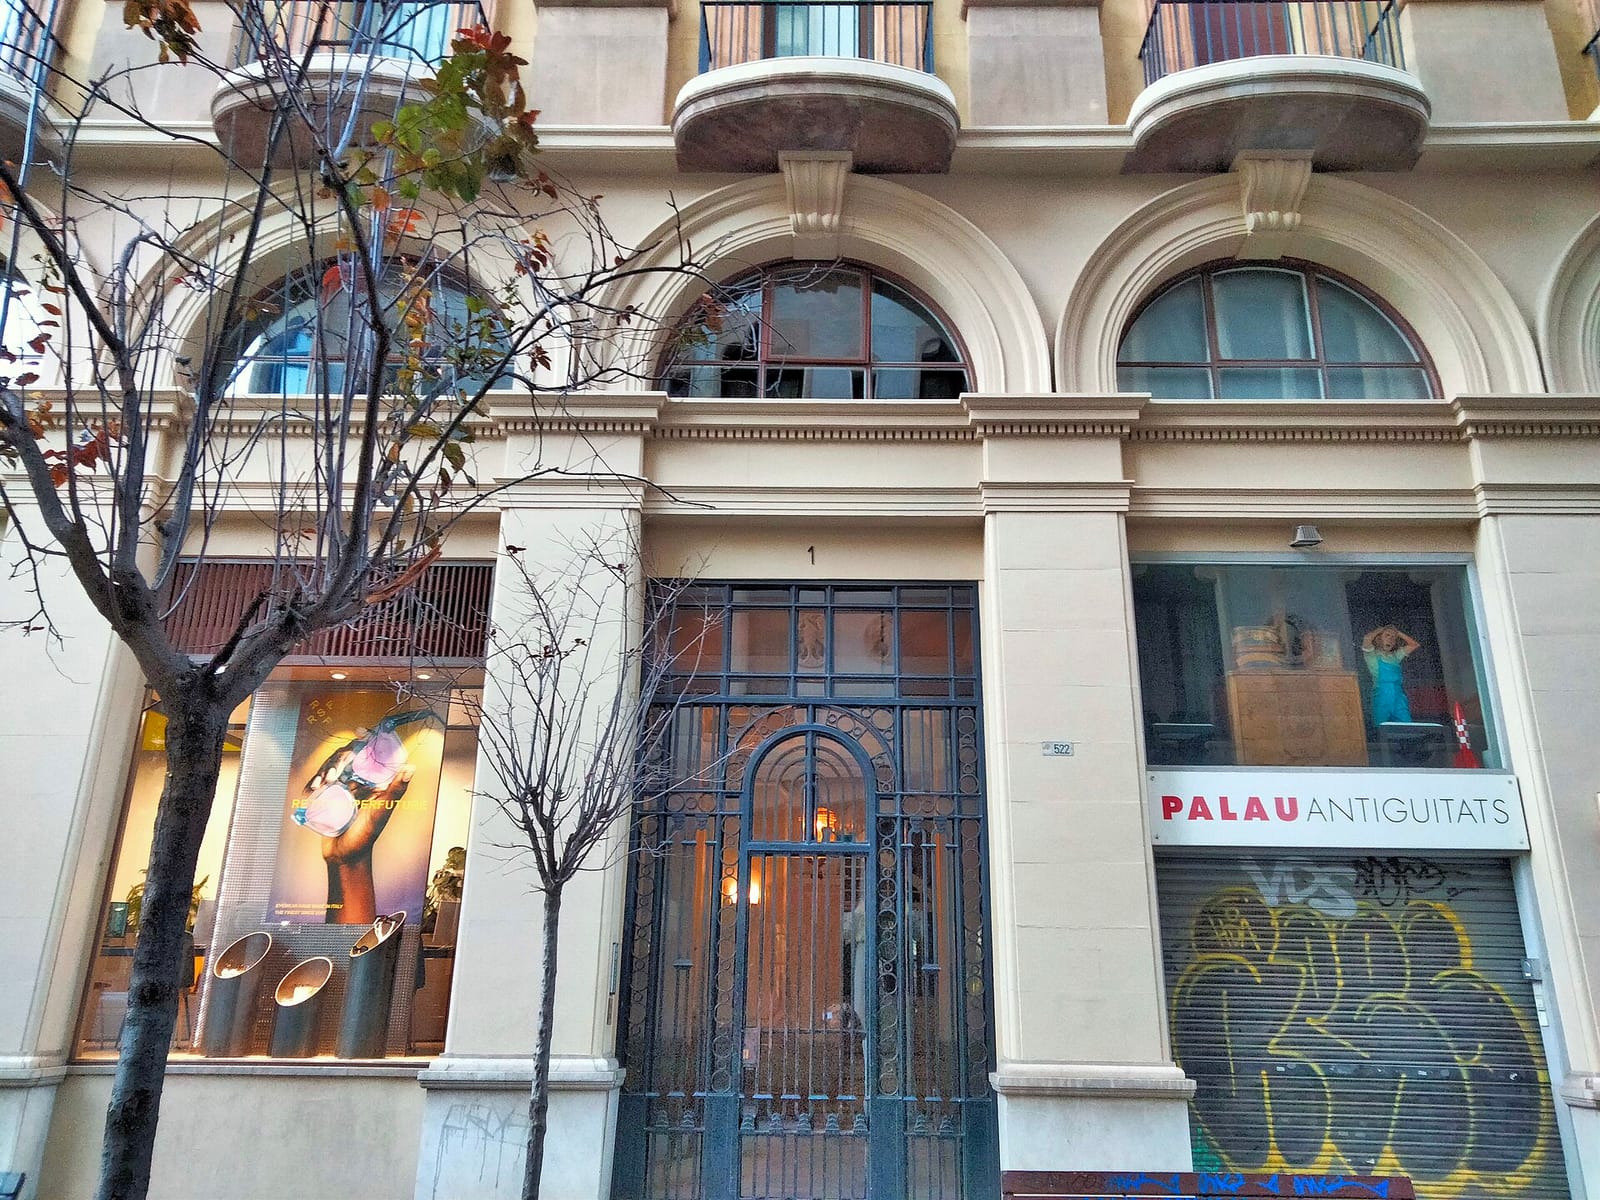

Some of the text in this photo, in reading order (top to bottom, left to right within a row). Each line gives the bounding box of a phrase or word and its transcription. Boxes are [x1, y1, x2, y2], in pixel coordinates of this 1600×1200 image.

[807, 545, 815, 565] 1
[1053, 743, 1070, 754] 522
[1161, 795, 1510, 824] PALAU ANTIGUITATS
